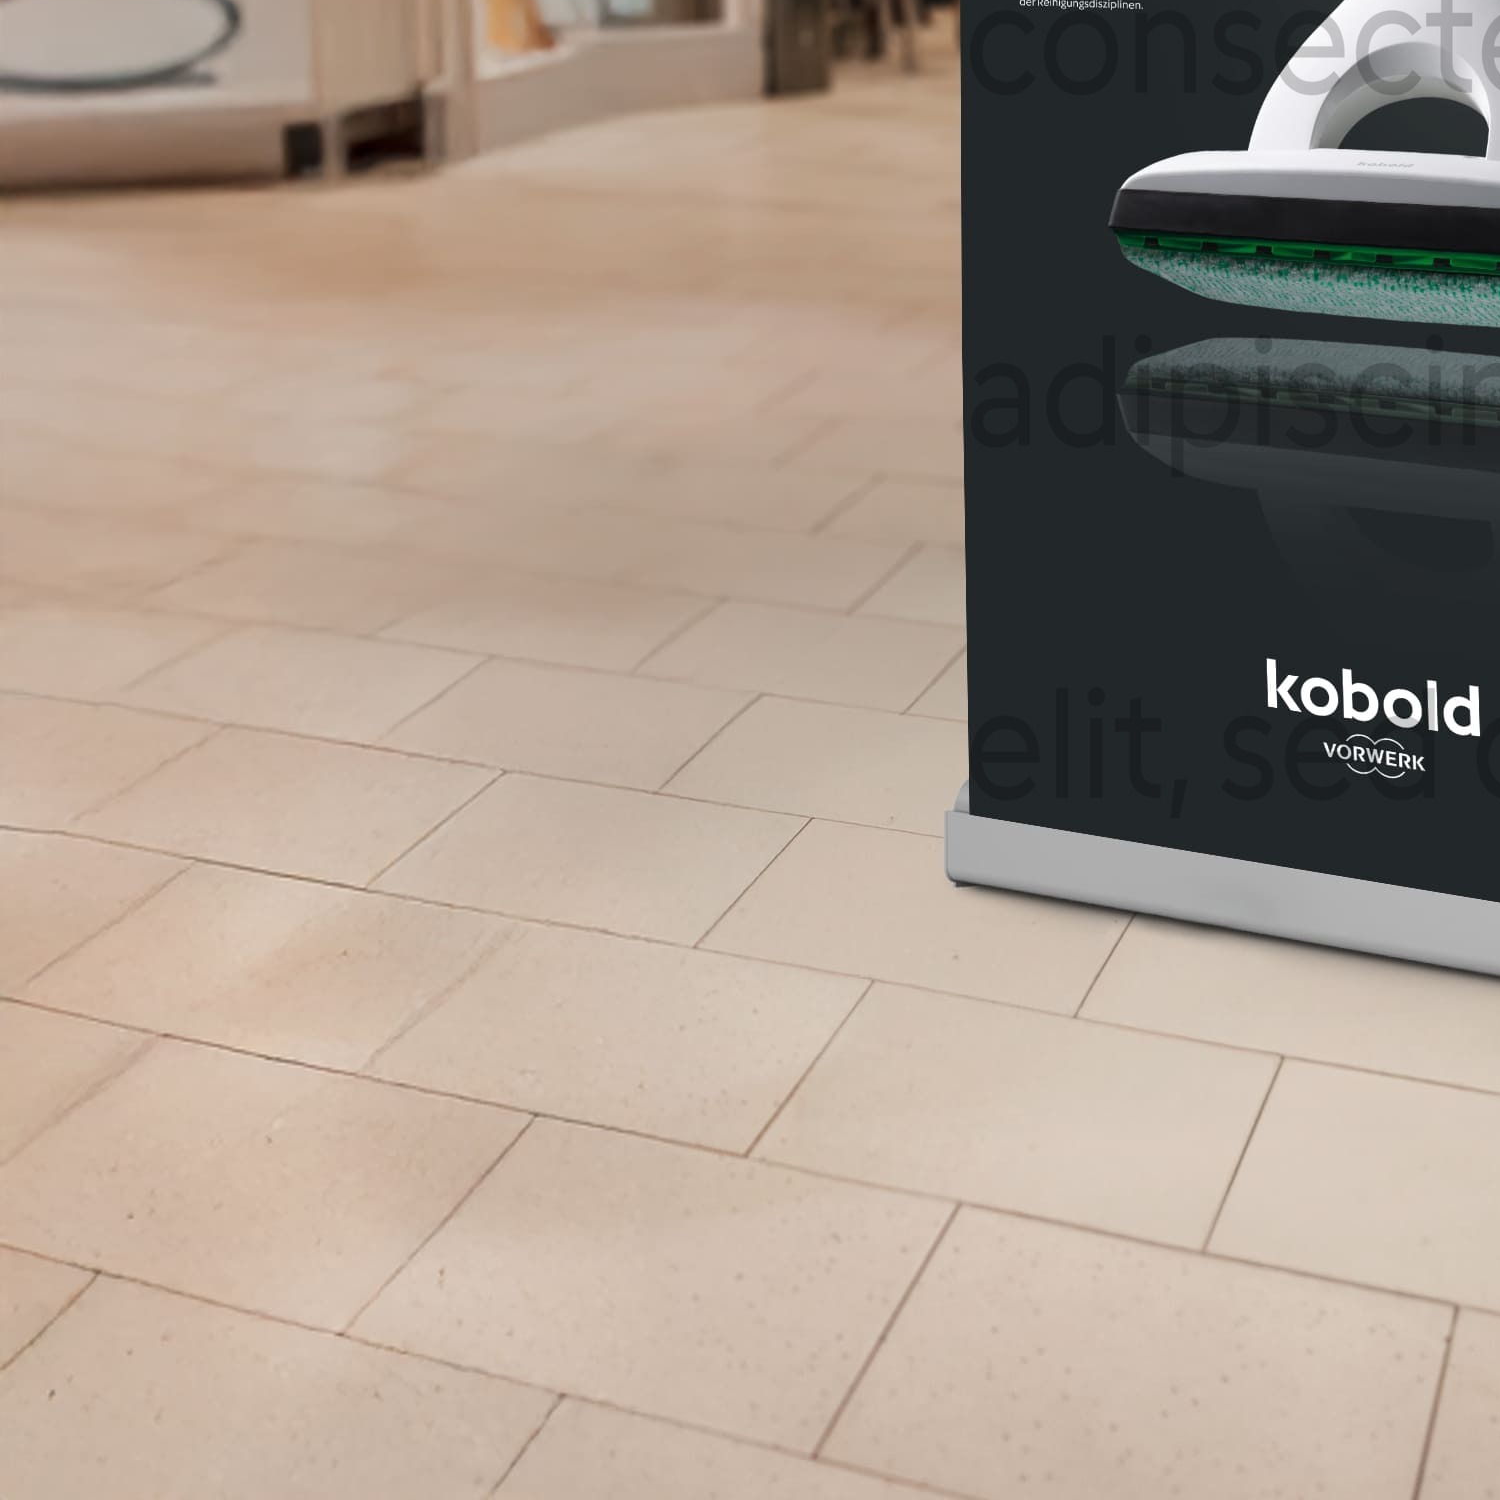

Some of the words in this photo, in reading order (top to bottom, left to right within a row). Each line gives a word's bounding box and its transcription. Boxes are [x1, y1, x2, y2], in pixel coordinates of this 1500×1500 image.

[1265, 657, 1481, 737] kobold
[969, 687, 1188, 820] elit,
[1220, 687, 1438, 804] sed
[1323, 741, 1426, 772] VORWERK
